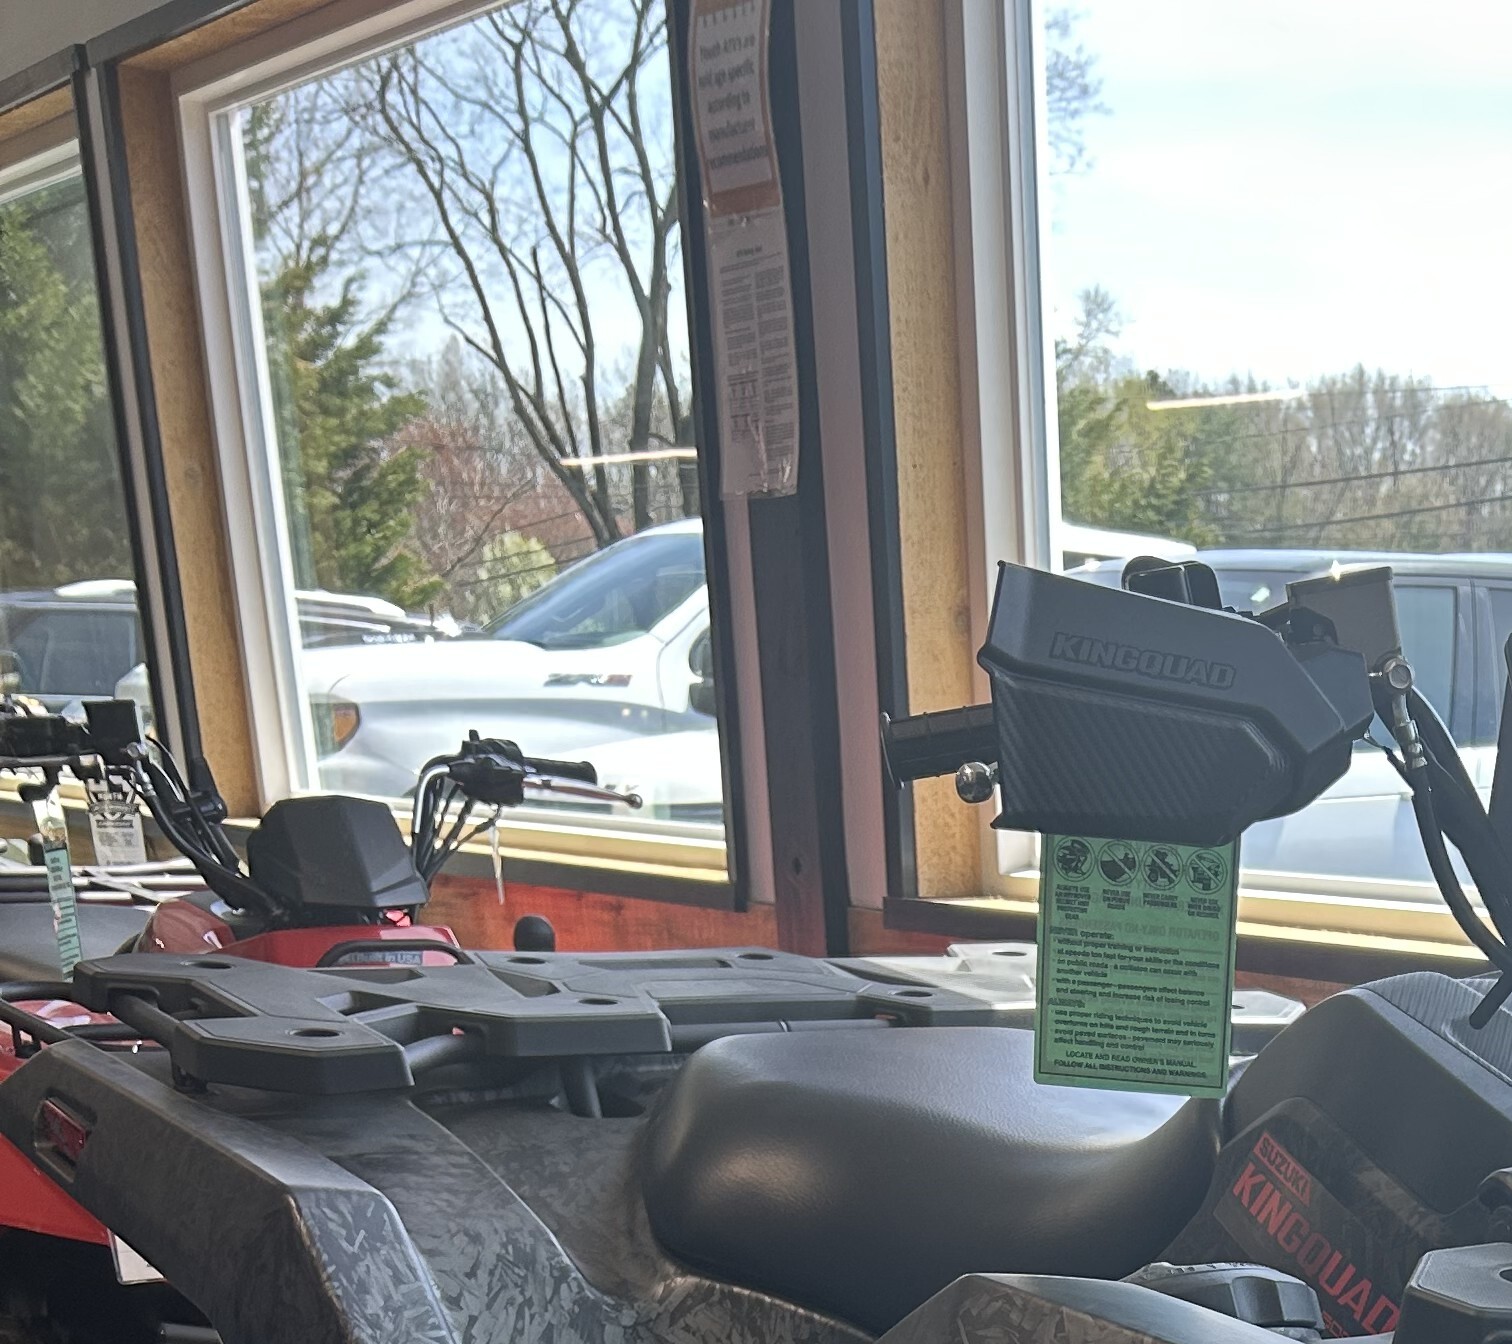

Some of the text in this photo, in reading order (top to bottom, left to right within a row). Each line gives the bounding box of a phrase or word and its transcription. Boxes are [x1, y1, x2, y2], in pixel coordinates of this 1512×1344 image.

[1050, 631, 1237, 691] KINGQUAD
[1256, 1134, 1311, 1202] SUZUKI
[1232, 1161, 1400, 1336] KINGQUAD
